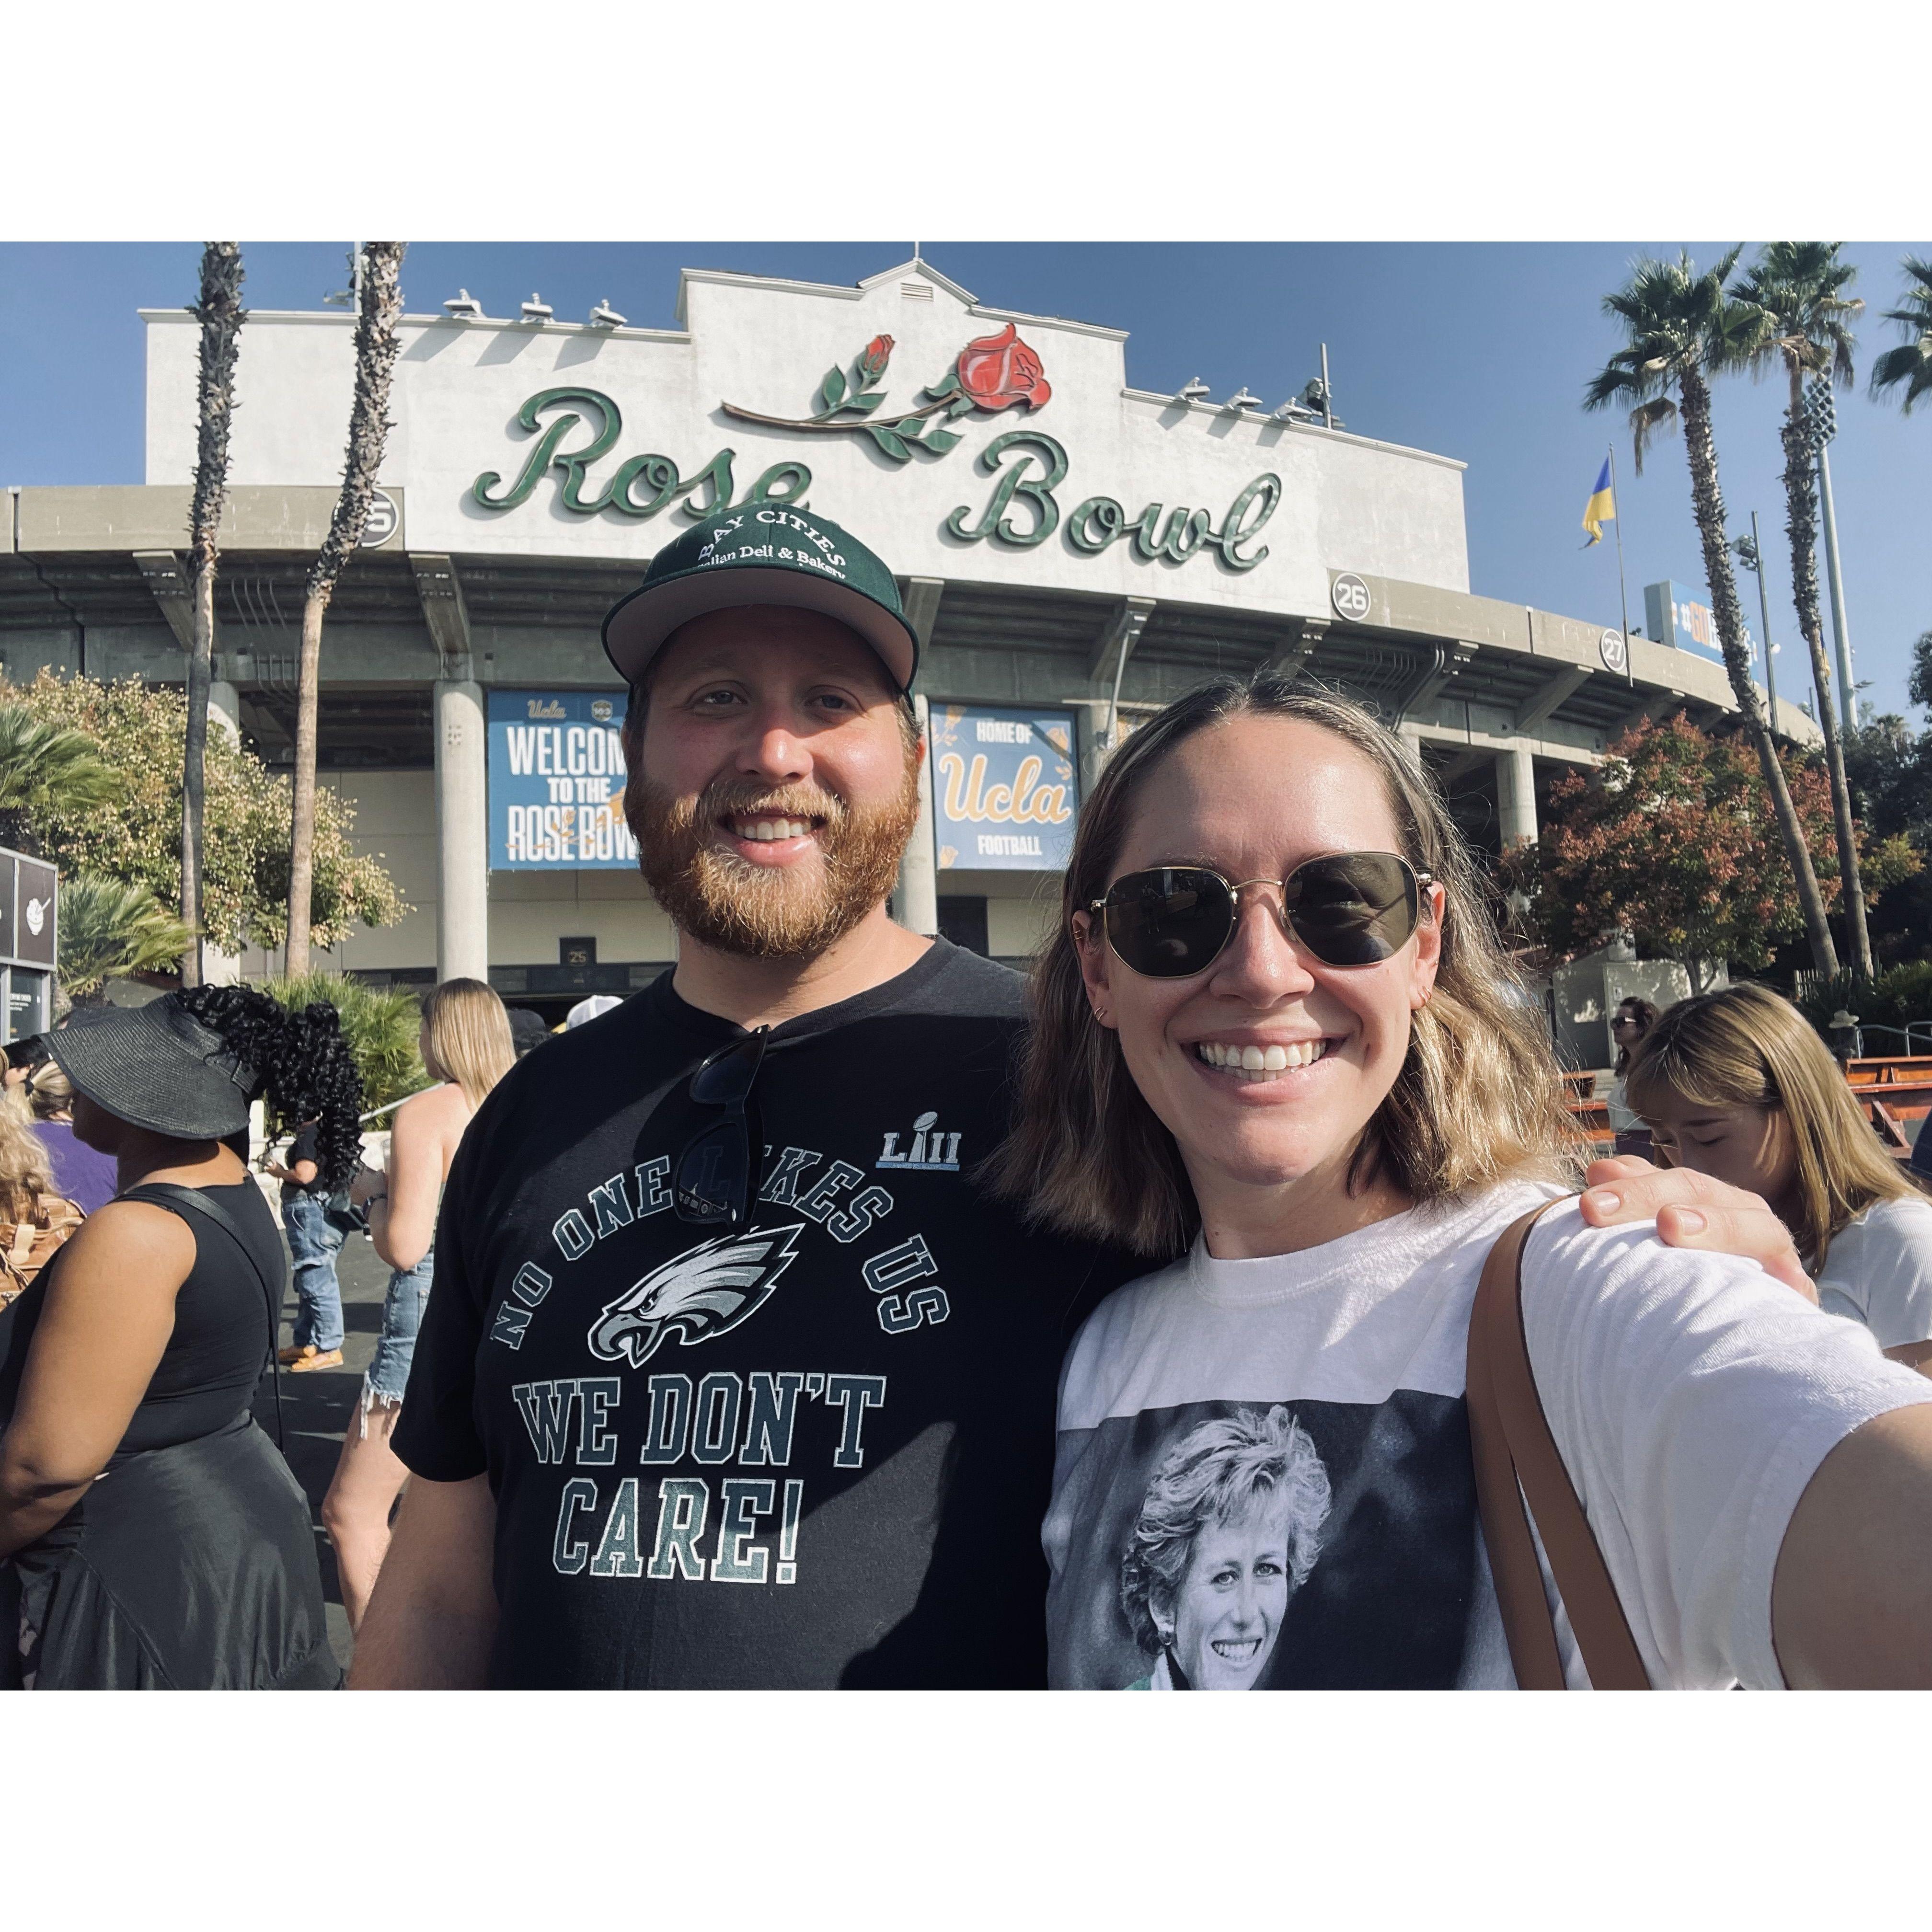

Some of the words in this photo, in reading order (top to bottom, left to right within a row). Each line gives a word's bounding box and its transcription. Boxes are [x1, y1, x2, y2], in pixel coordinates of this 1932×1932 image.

[472, 387, 812, 519] Rose
[948, 430, 1282, 571] Bowl
[367, 501, 391, 532] 5
[698, 515, 745, 561] BAY
[756, 510, 846, 566] CITIES
[739, 544, 773, 558] Deli
[777, 547, 794, 560] &
[1336, 583, 1367, 611] 26
[1604, 637, 1622, 662] 27
[506, 726, 627, 776] WELCOM
[976, 720, 1014, 743] HOME
[1015, 724, 1033, 744] OF
[547, 777, 574, 804] TO
[575, 777, 611, 804] THE
[938, 752, 1071, 824] Ucla
[507, 805, 575, 862] ROSE
[578, 805, 638, 861] BOW
[977, 835, 1043, 856] FOOTBALL
[489, 1260, 553, 1351] NO
[551, 1154, 674, 1262] ONE
[861, 1233, 951, 1335] US
[511, 1376, 621, 1465] WE
[640, 1371, 888, 1469] DON'T
[552, 1477, 805, 1585] CARE!
